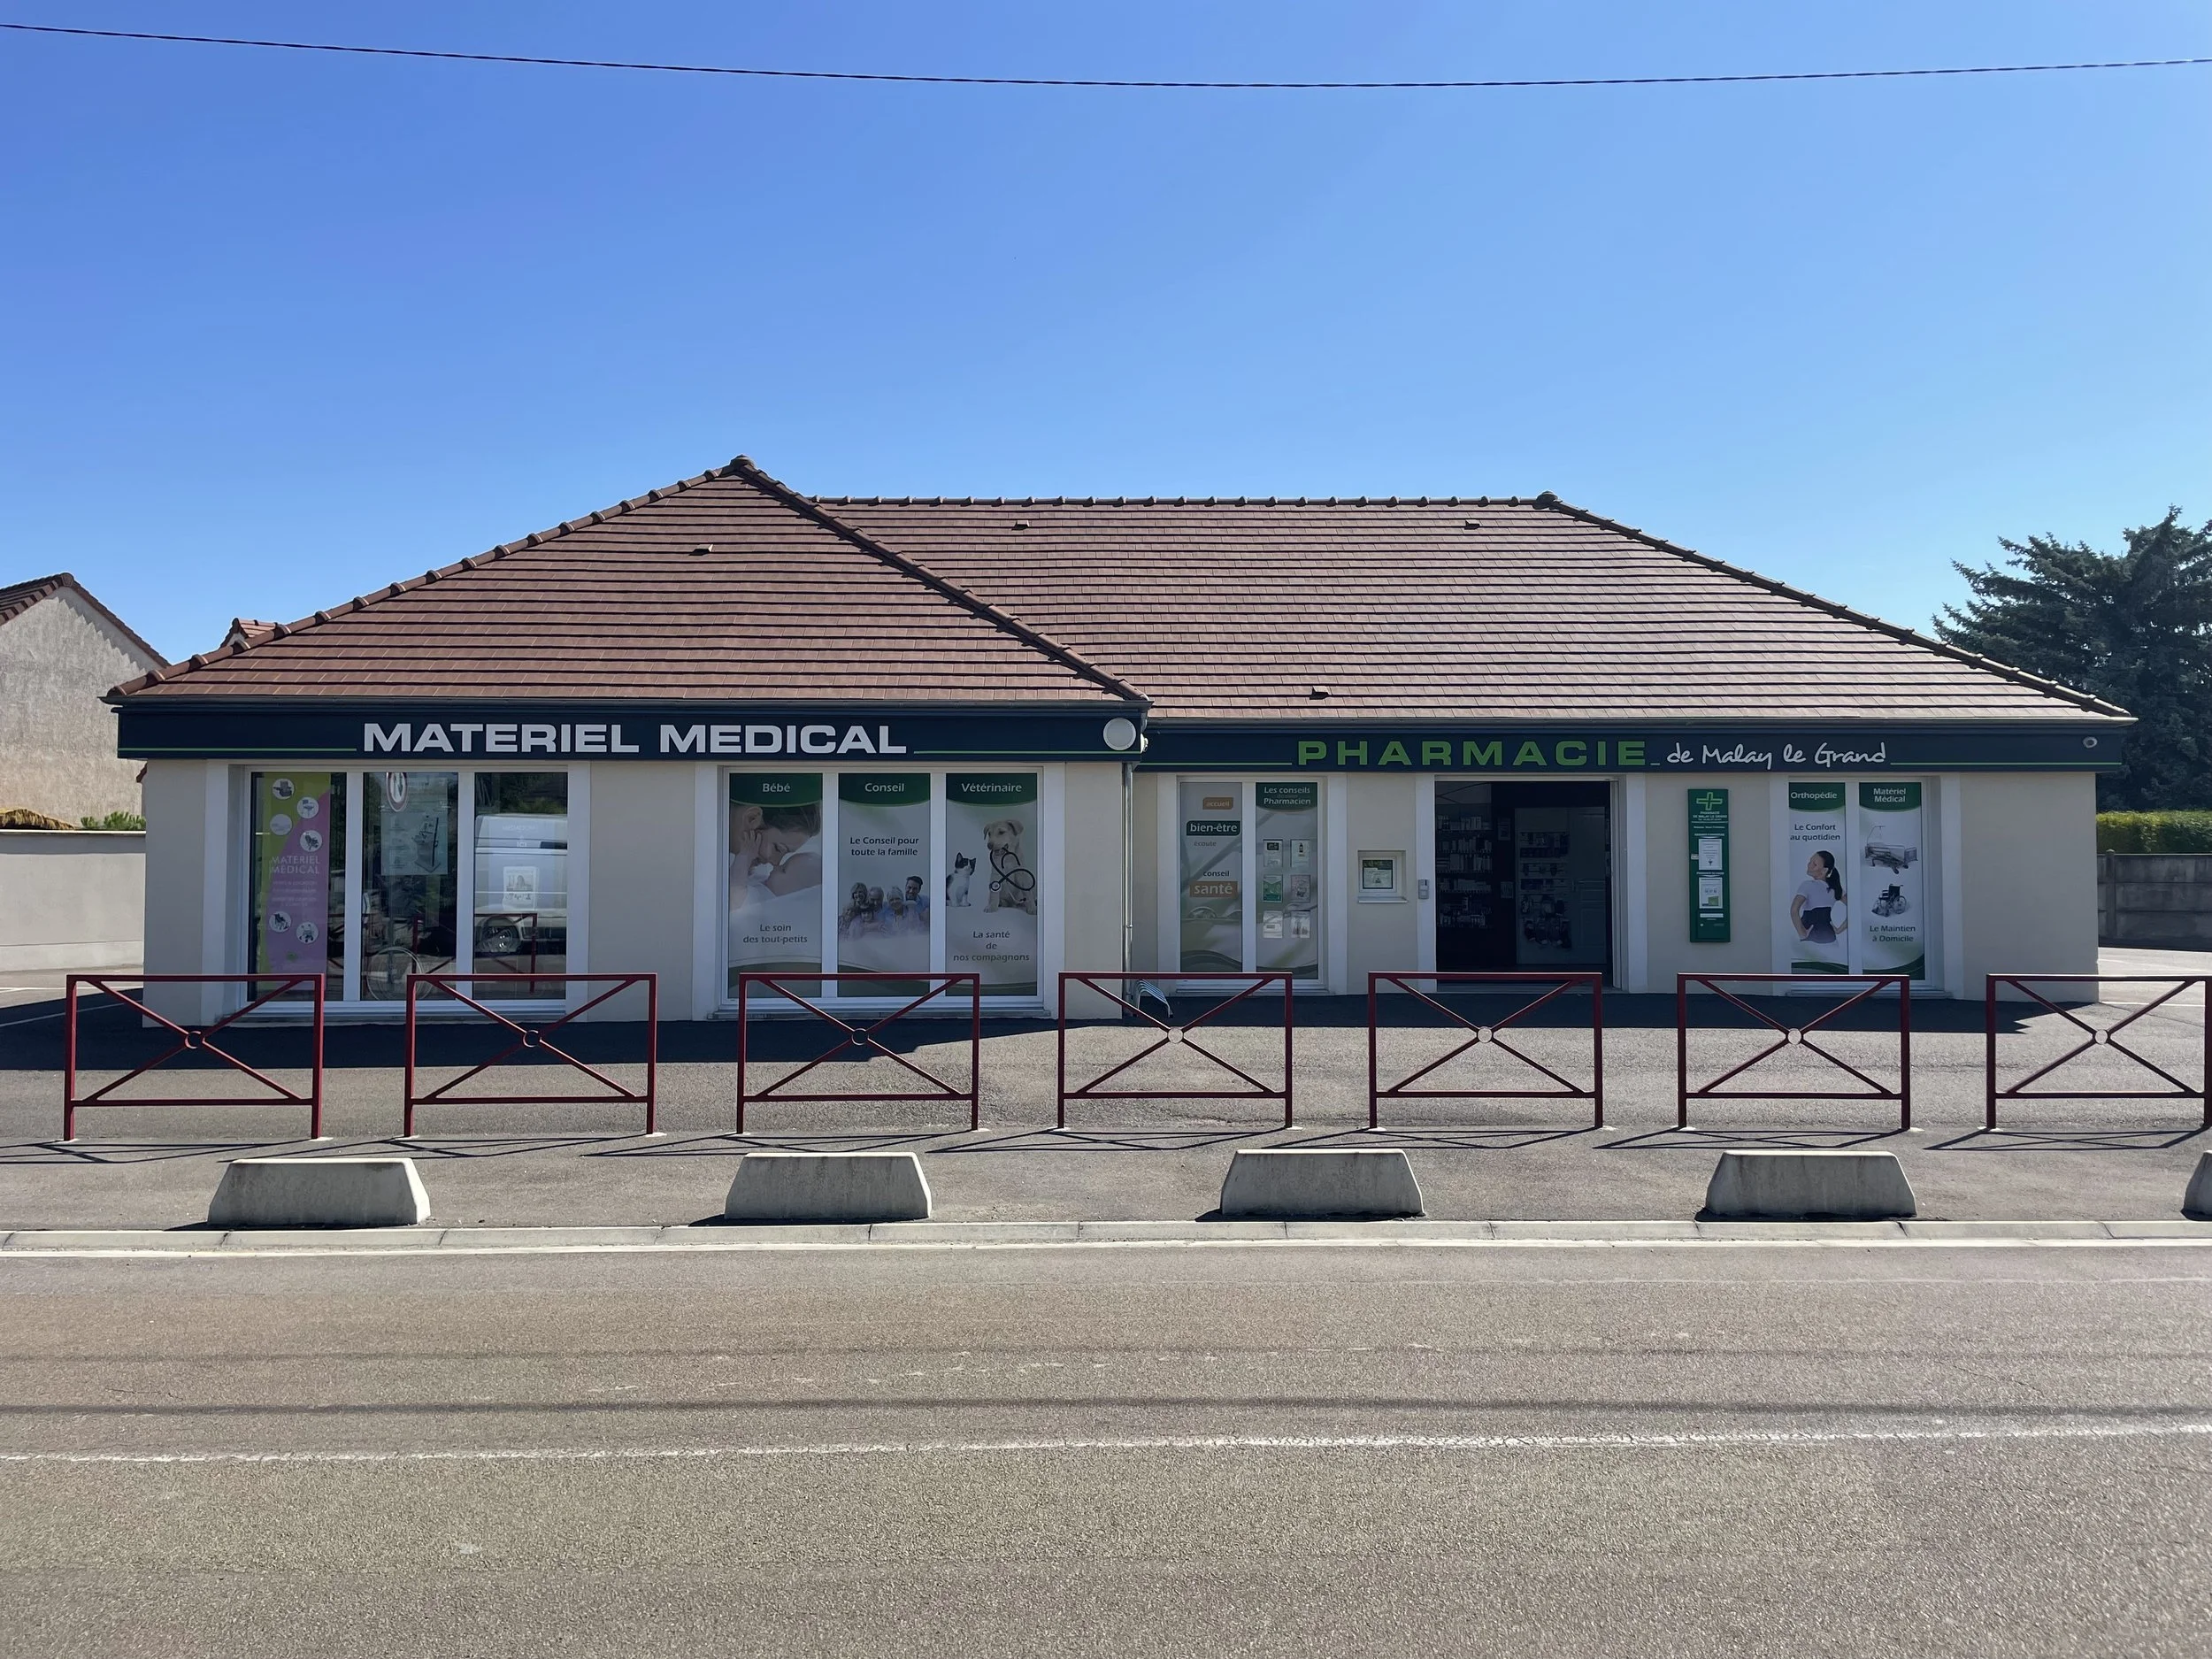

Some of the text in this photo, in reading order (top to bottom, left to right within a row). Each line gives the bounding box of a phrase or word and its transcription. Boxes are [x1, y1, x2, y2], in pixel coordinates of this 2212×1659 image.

[363, 723, 907, 754] MATERIEL MEDICAL
[1297, 741, 1646, 766] PHARMACIE
[1666, 741, 1886, 770] de Malay le Grand
[762, 783, 791, 793] Bébé
[864, 782, 905, 793] Conseil
[961, 783, 1023, 793] Vétérinaire
[1790, 791, 1838, 801] Orthopédie
[1189, 823, 1238, 833] bien-être
[863, 836, 895, 845] Conseil
[897, 838, 919, 847] pour
[1194, 884, 1233, 895] santé
[972, 929, 1010, 939] La santé
[761, 935, 808, 945] tout-petits
